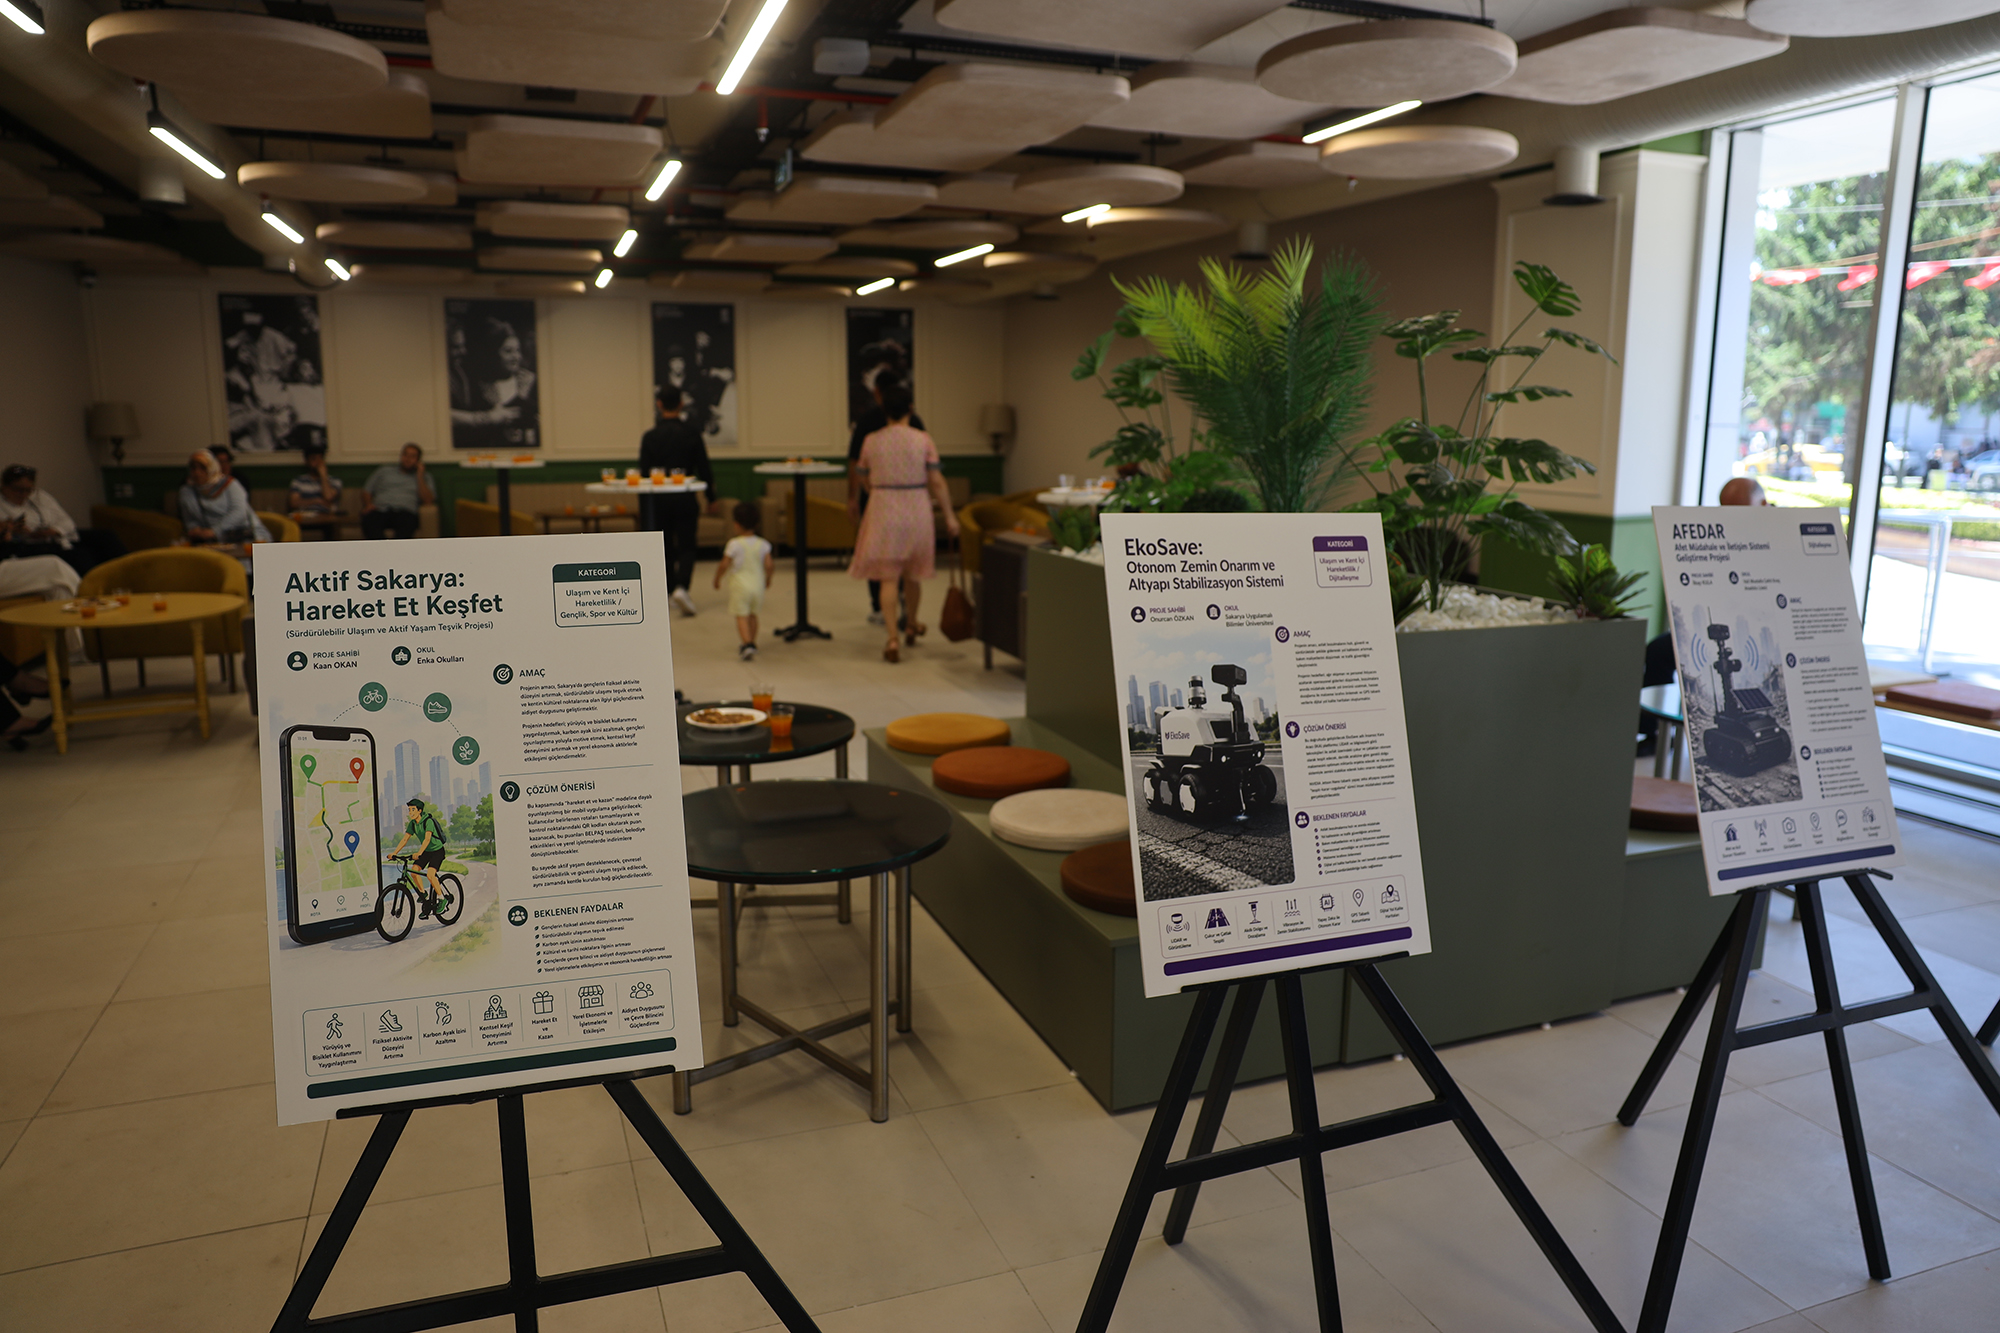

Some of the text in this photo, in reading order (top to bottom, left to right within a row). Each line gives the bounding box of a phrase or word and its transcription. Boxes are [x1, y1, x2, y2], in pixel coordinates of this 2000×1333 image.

[1673, 524, 1725, 539] AFEDAR
[1125, 538, 1203, 556] EkoSave:
[1675, 543, 1688, 551] Afet
[1689, 543, 1718, 551] Müdahale
[1727, 542, 1748, 552] İletişim
[1748, 542, 1770, 550] Sistemi
[1676, 553, 1730, 563] Geliştirme Projesi
[578, 567, 616, 576] KATEGORİ
[1127, 560, 1275, 574] Otonom Zemin Onarım ve
[285, 569, 464, 593] Aktif Sakarya:
[1129, 575, 1284, 593] Altyapı Stabilizasyon Sistemi
[621, 587, 630, 595] İçi
[287, 593, 503, 621] Hareket Et Keşfet
[575, 599, 616, 607] Hareketlilik
[560, 611, 589, 619] Gençlik,
[590, 610, 606, 618] Spor
[286, 628, 345, 639] (Sürdürülebilir
[347, 628, 375, 636] Ulaşım
[389, 625, 408, 633] Aktif
[410, 625, 436, 633] Yaşam
[438, 623, 463, 632] Teşvik
[465, 621, 494, 631] Projesi)
[1293, 630, 1311, 638] AMAÇ
[336, 650, 360, 658] SAHİBİ
[334, 661, 357, 669] OKAN
[520, 669, 546, 678] AMAÇ
[1303, 722, 1347, 733] ÇÖZÜM ÖNERİSİ
[1170, 731, 1190, 740] EkoSave
[526, 781, 595, 796] ÇÖZÜM ÖNERİSİ
[1313, 810, 1366, 822] BEKLENEN FAYDALAR
[534, 902, 624, 918] BEKLENEN FAYDALAR
[579, 1019, 607, 1028] İşletmelerle
[629, 1021, 660, 1029] Güçlendirme
[482, 1031, 512, 1039] Deneyimini
[382, 1044, 404, 1052] Düzeyini
[319, 1060, 357, 1068] Yaygınlaştırma
